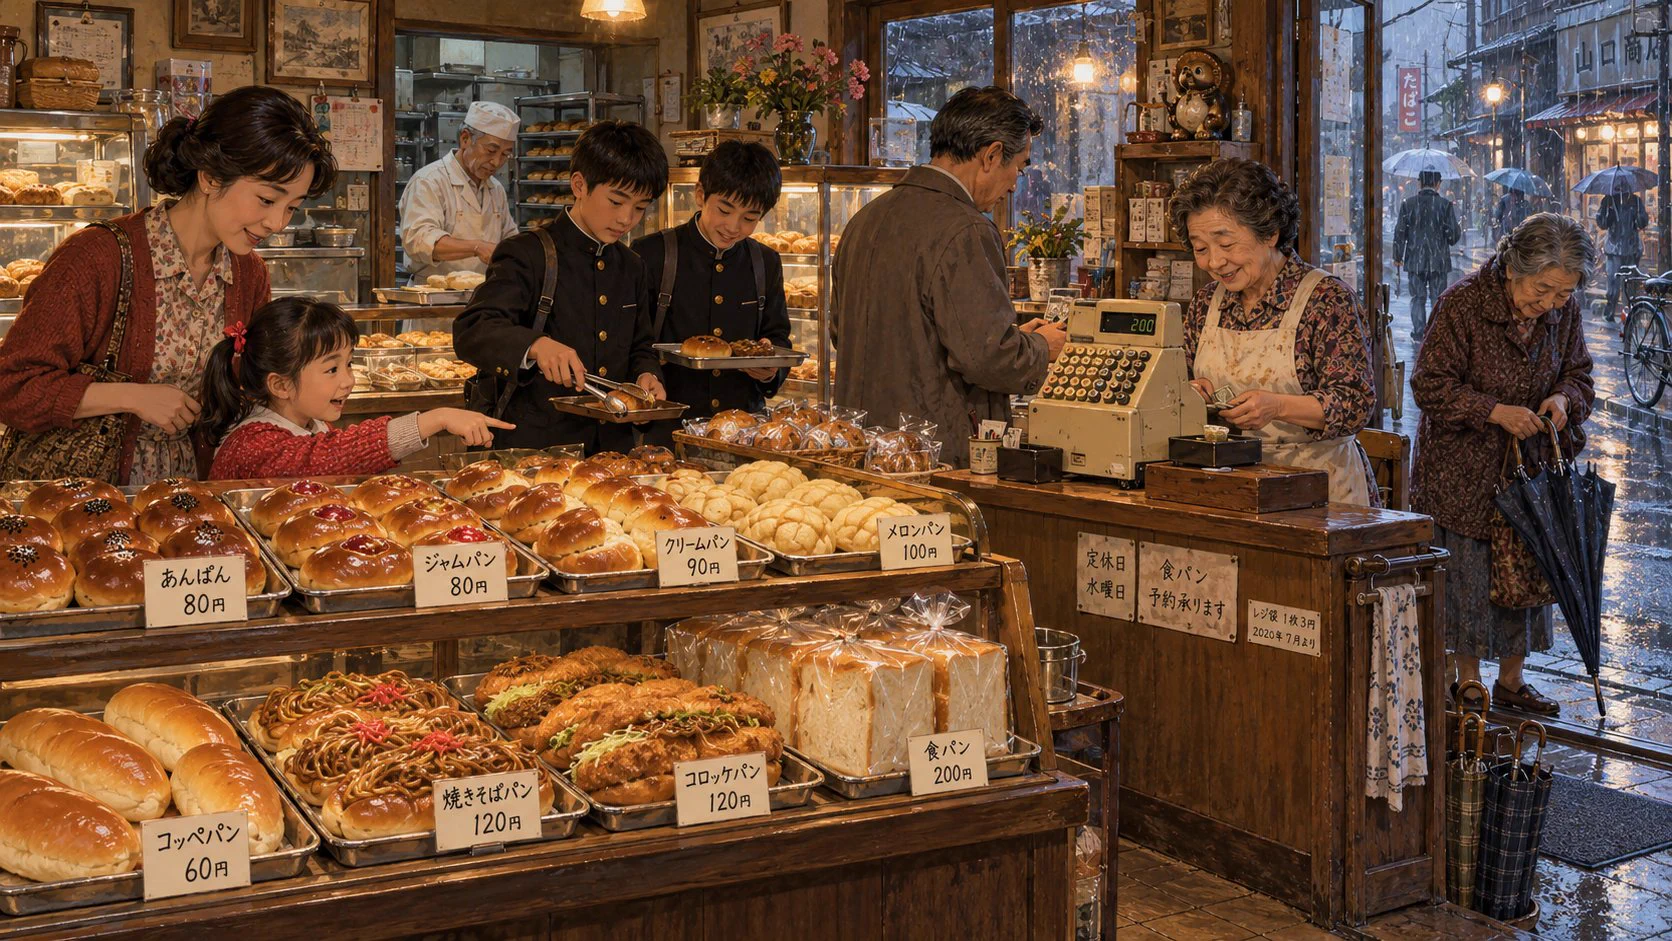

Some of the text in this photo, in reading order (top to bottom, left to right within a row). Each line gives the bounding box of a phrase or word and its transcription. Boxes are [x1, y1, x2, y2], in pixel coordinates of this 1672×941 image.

[1403, 72, 1417, 127] たばこ
[1131, 318, 1154, 333] 200
[887, 522, 945, 540] メロンパン
[665, 535, 730, 555] クリームパン
[905, 544, 936, 560] 100円
[426, 551, 495, 572] ジャムパン
[688, 558, 719, 576] 90円
[1087, 549, 1124, 571] 定休日
[162, 565, 230, 588] あんぱん
[1160, 559, 1207, 583] 食パン
[451, 577, 486, 596] 80円
[1087, 578, 1124, 600] 水曜日
[184, 594, 224, 615] 80円
[1149, 588, 1225, 619] 予約承ります
[925, 740, 969, 761] 食パン
[686, 764, 760, 787] コロッケパン
[935, 765, 971, 784] 200円
[442, 780, 533, 810] 焼きそばパン
[711, 791, 750, 812] 120円
[475, 812, 520, 835] 120円
[158, 823, 239, 851] コッペパン
[186, 857, 227, 882] 60円
